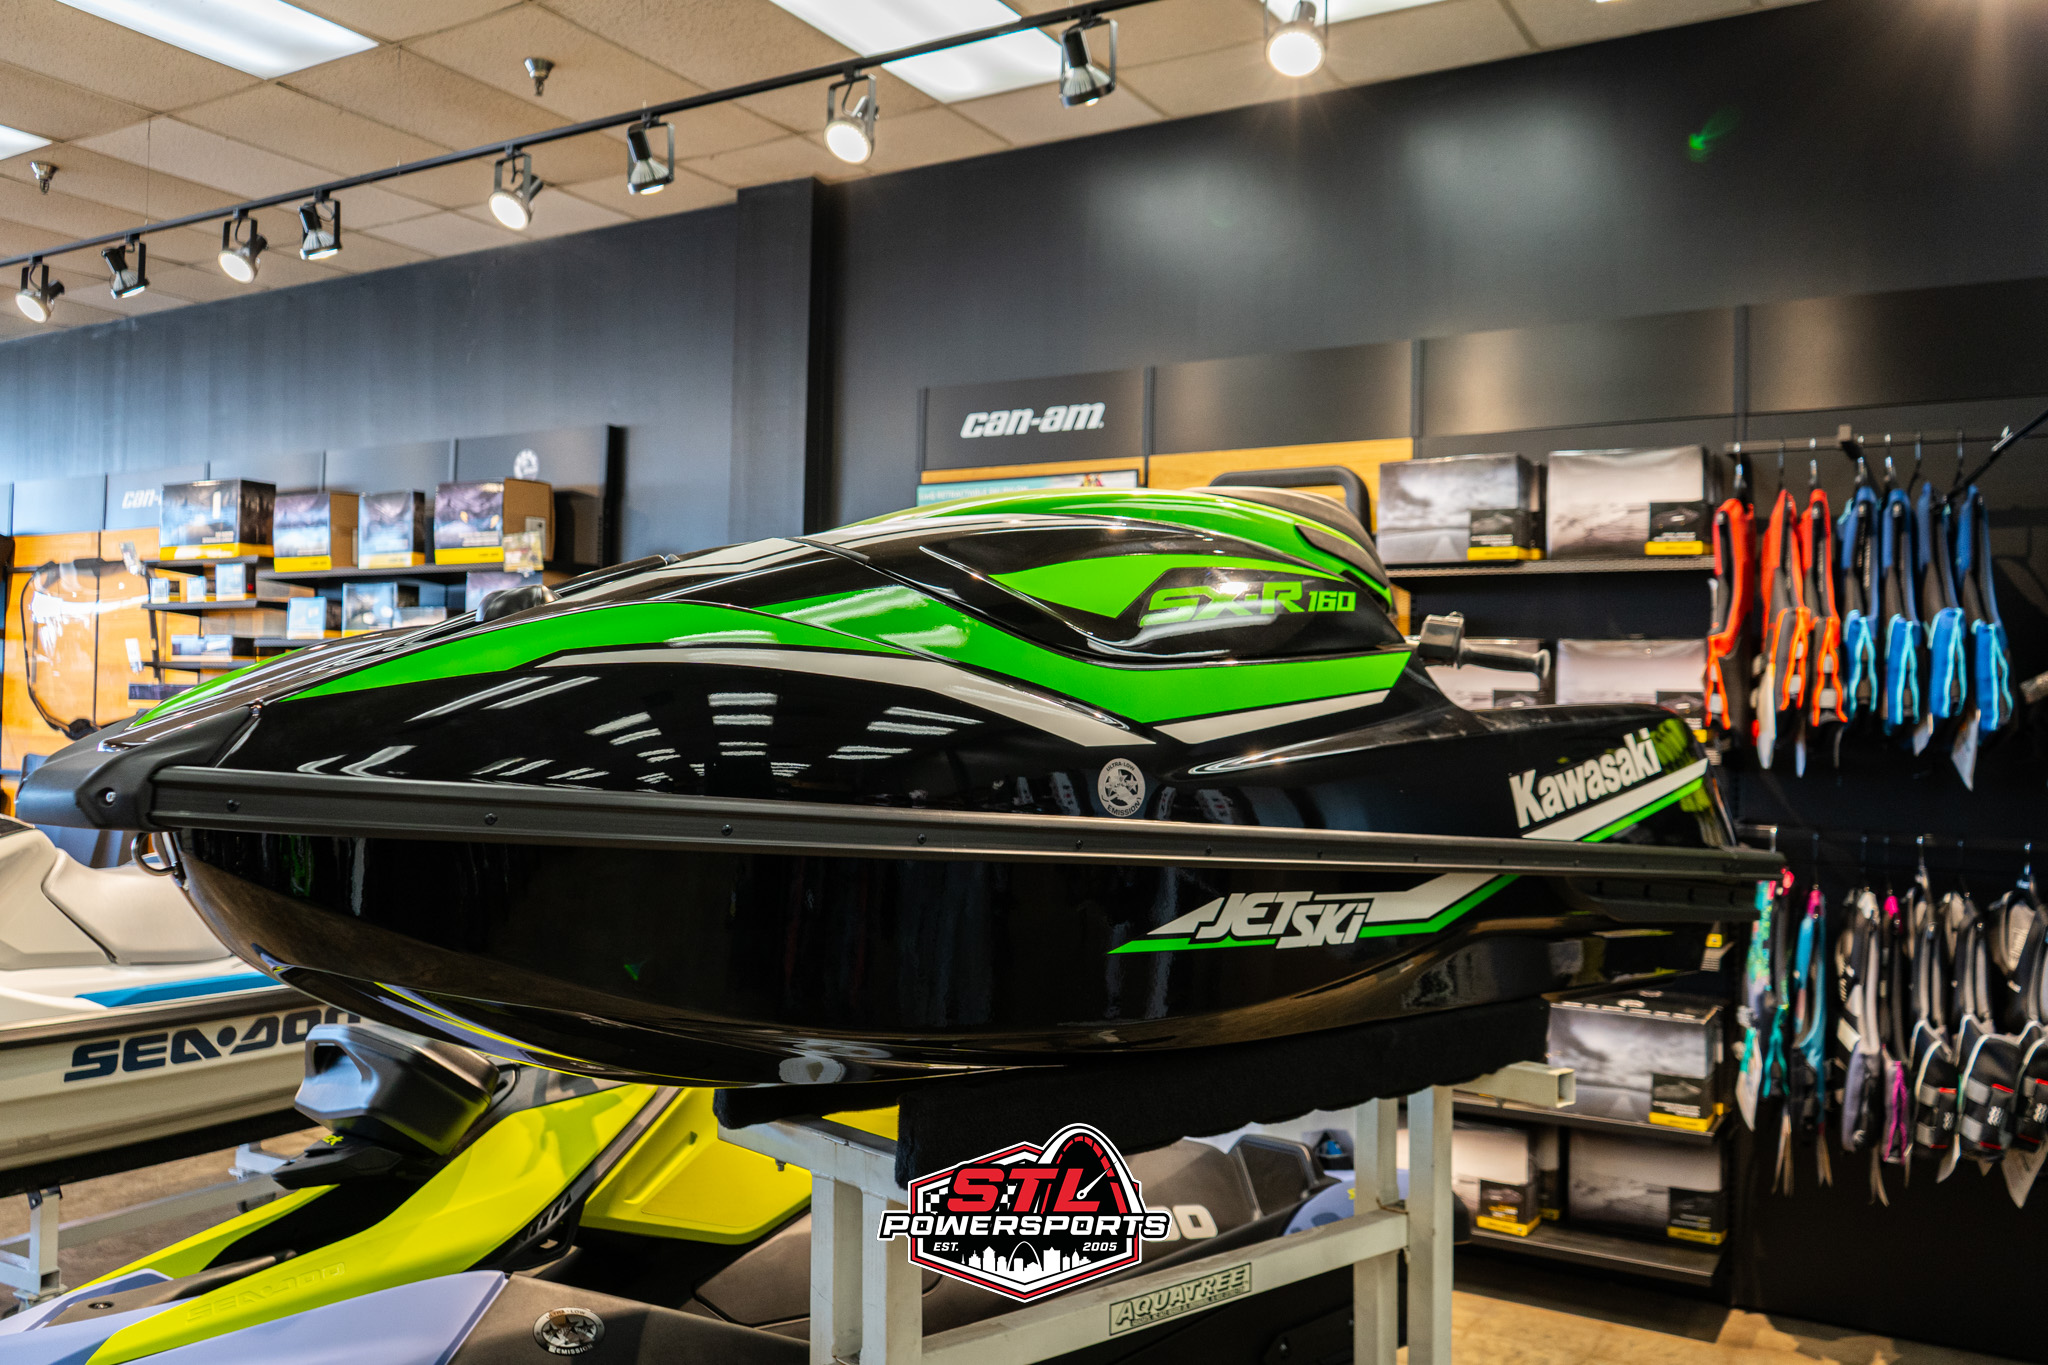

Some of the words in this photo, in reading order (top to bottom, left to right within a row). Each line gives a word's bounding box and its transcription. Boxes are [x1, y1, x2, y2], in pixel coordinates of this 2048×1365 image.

[960, 402, 1105, 438] can-am
[122, 488, 162, 509] can-
[1307, 590, 1357, 612] 160
[1508, 727, 1662, 829] Kawasaki
[1107, 800, 1141, 816] EMISSION
[1115, 1268, 1246, 1327] AQUATREE
